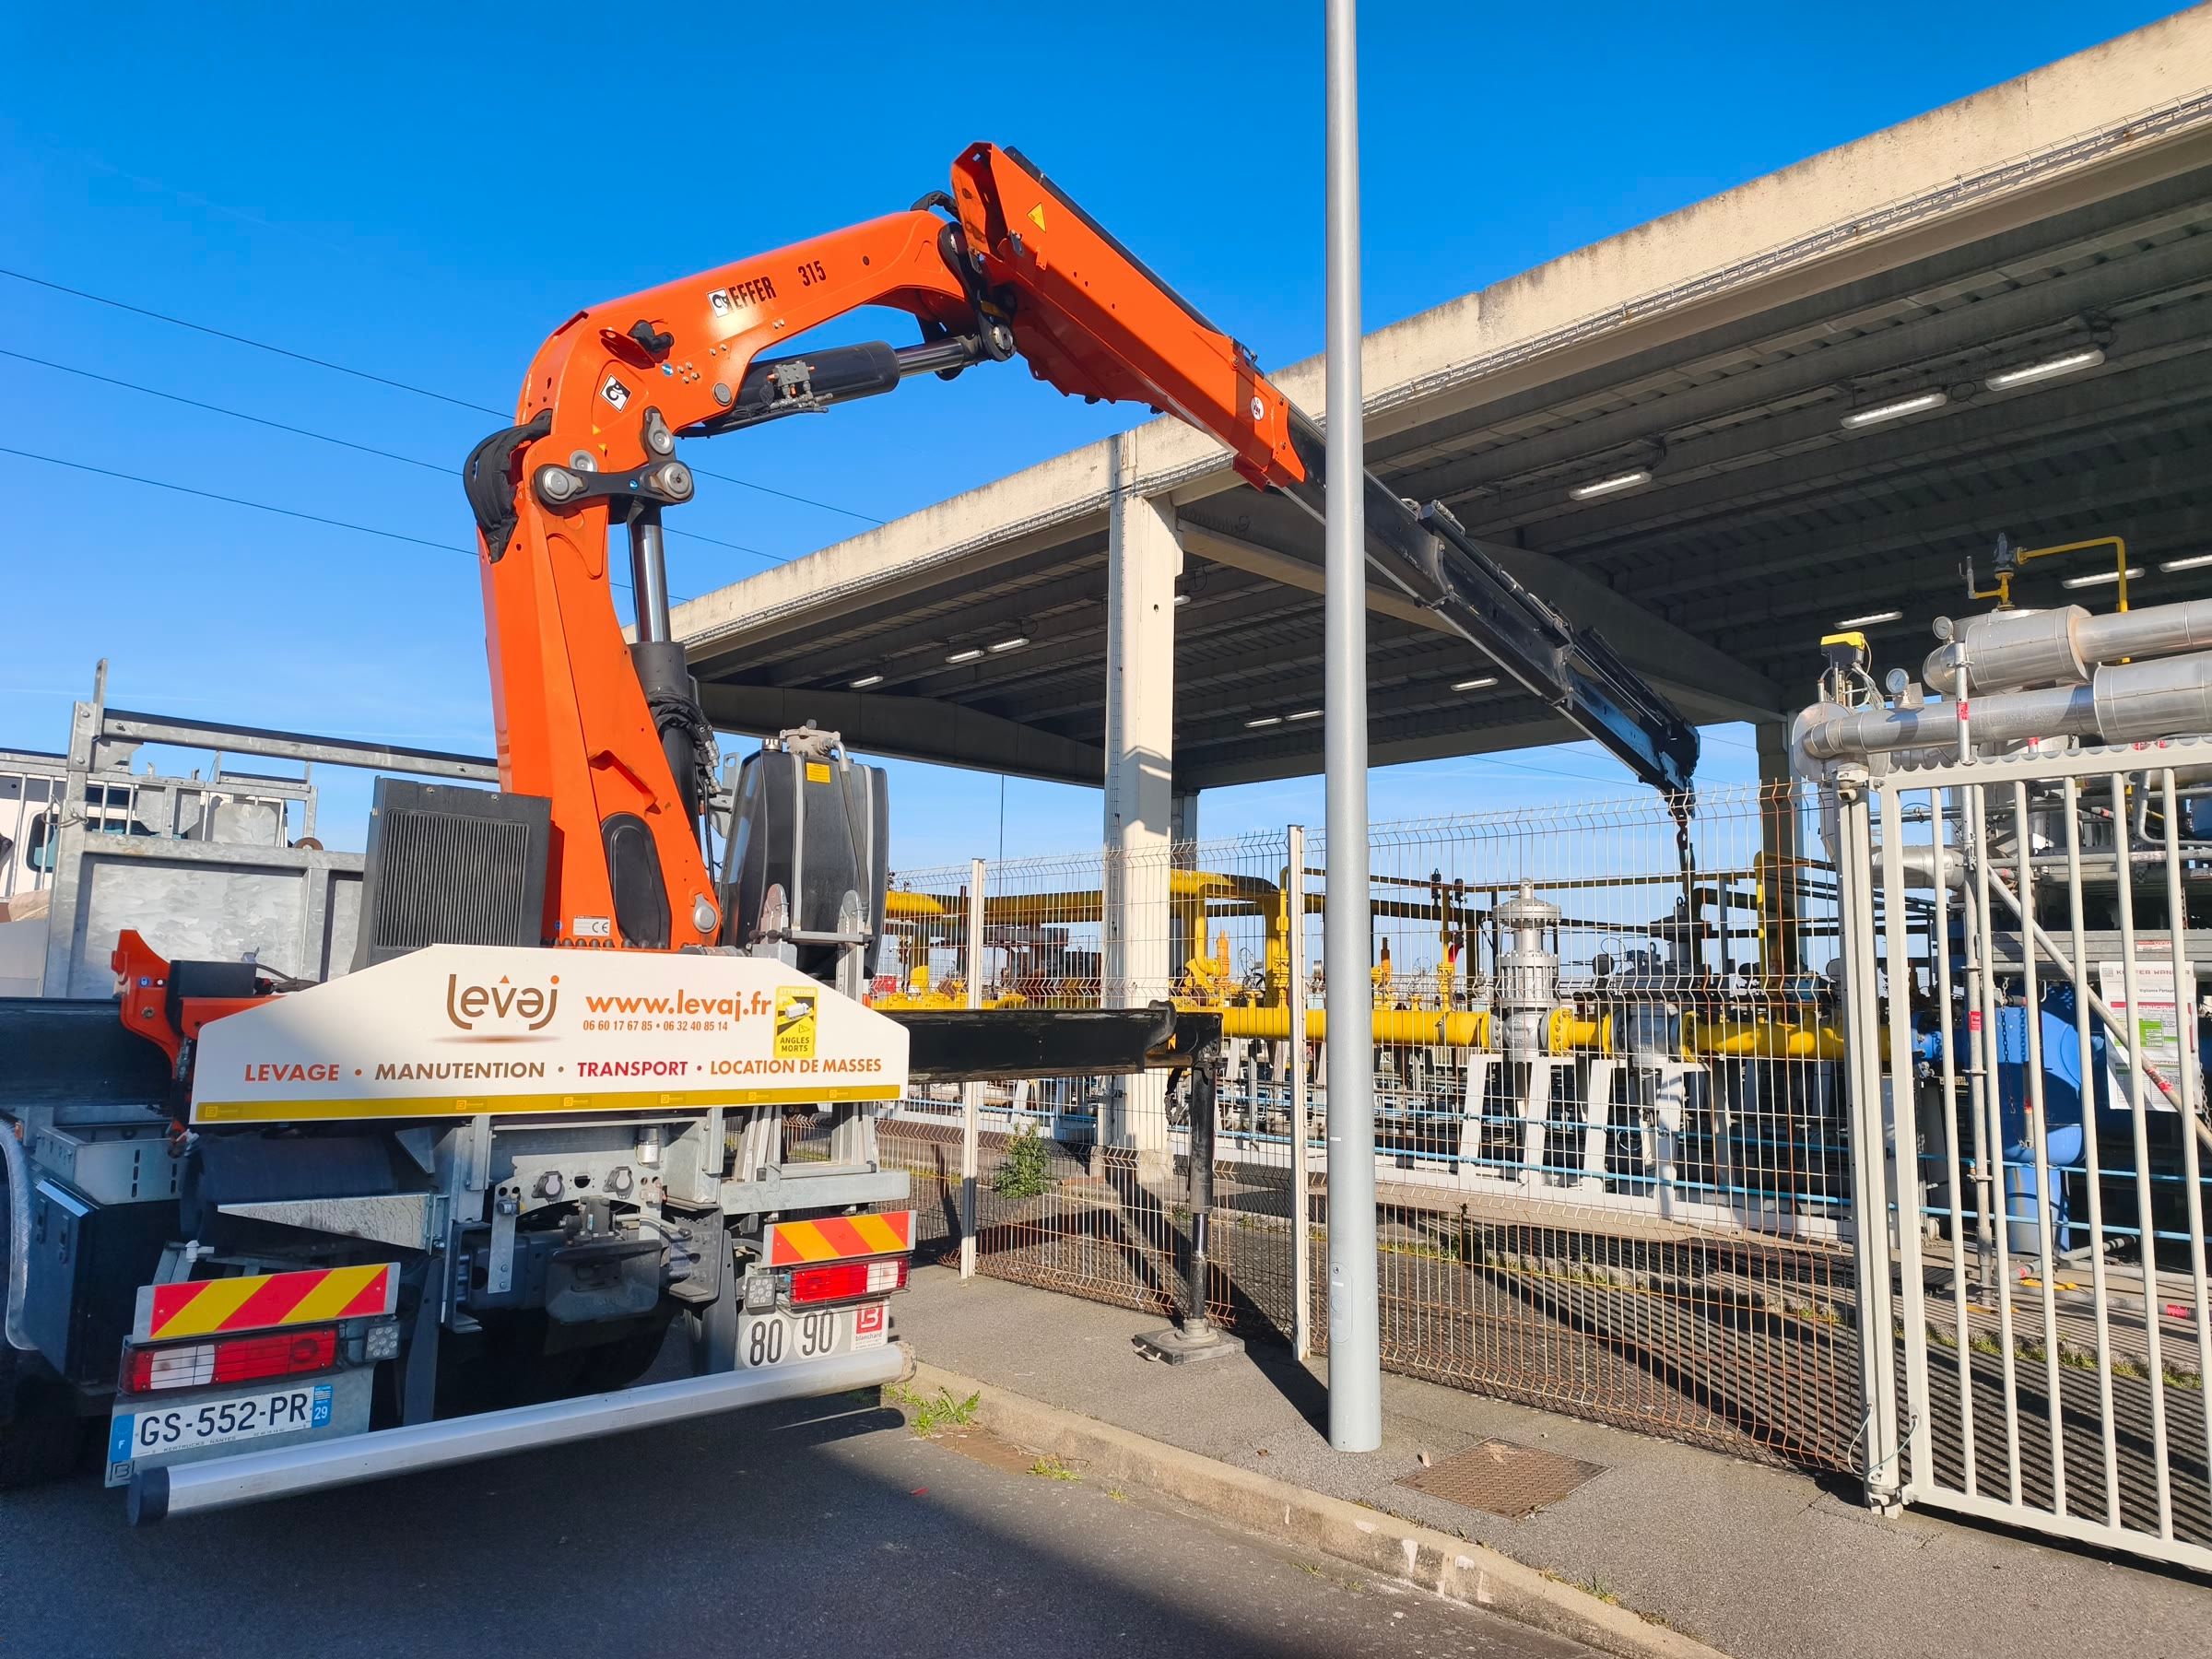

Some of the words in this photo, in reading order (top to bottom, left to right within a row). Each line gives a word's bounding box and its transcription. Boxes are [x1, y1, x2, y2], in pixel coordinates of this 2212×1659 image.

[728, 276, 777, 310] EFFER
[797, 260, 826, 287] 315
[592, 921, 609, 934] CE
[447, 973, 559, 1030] levaj
[585, 989, 772, 1022] www.levaj.fr
[582, 1019, 595, 1031] 06
[598, 1019, 610, 1031] 60
[614, 1020, 624, 1031] 17
[627, 1020, 639, 1031] 67
[641, 1020, 653, 1031] 85
[663, 1020, 675, 1031] 06
[677, 1020, 688, 1031] 32
[690, 1020, 701, 1031] 40
[703, 1020, 715, 1031] 85
[717, 1021, 728, 1031] 14
[781, 1044, 808, 1053] MORTS
[244, 1064, 340, 1082] LEVAGE
[374, 1062, 546, 1080] MANUTENTION
[577, 1061, 688, 1077] TRANSPORT
[710, 1059, 795, 1076] LOCATION
[799, 1059, 819, 1074] DE
[822, 1058, 882, 1073] MASSES
[749, 1318, 783, 1367] 80
[802, 1310, 834, 1357] 90
[140, 1393, 309, 1447] GS-552-PR
[313, 1406, 328, 1420] 29
[118, 1440, 124, 1450] F
